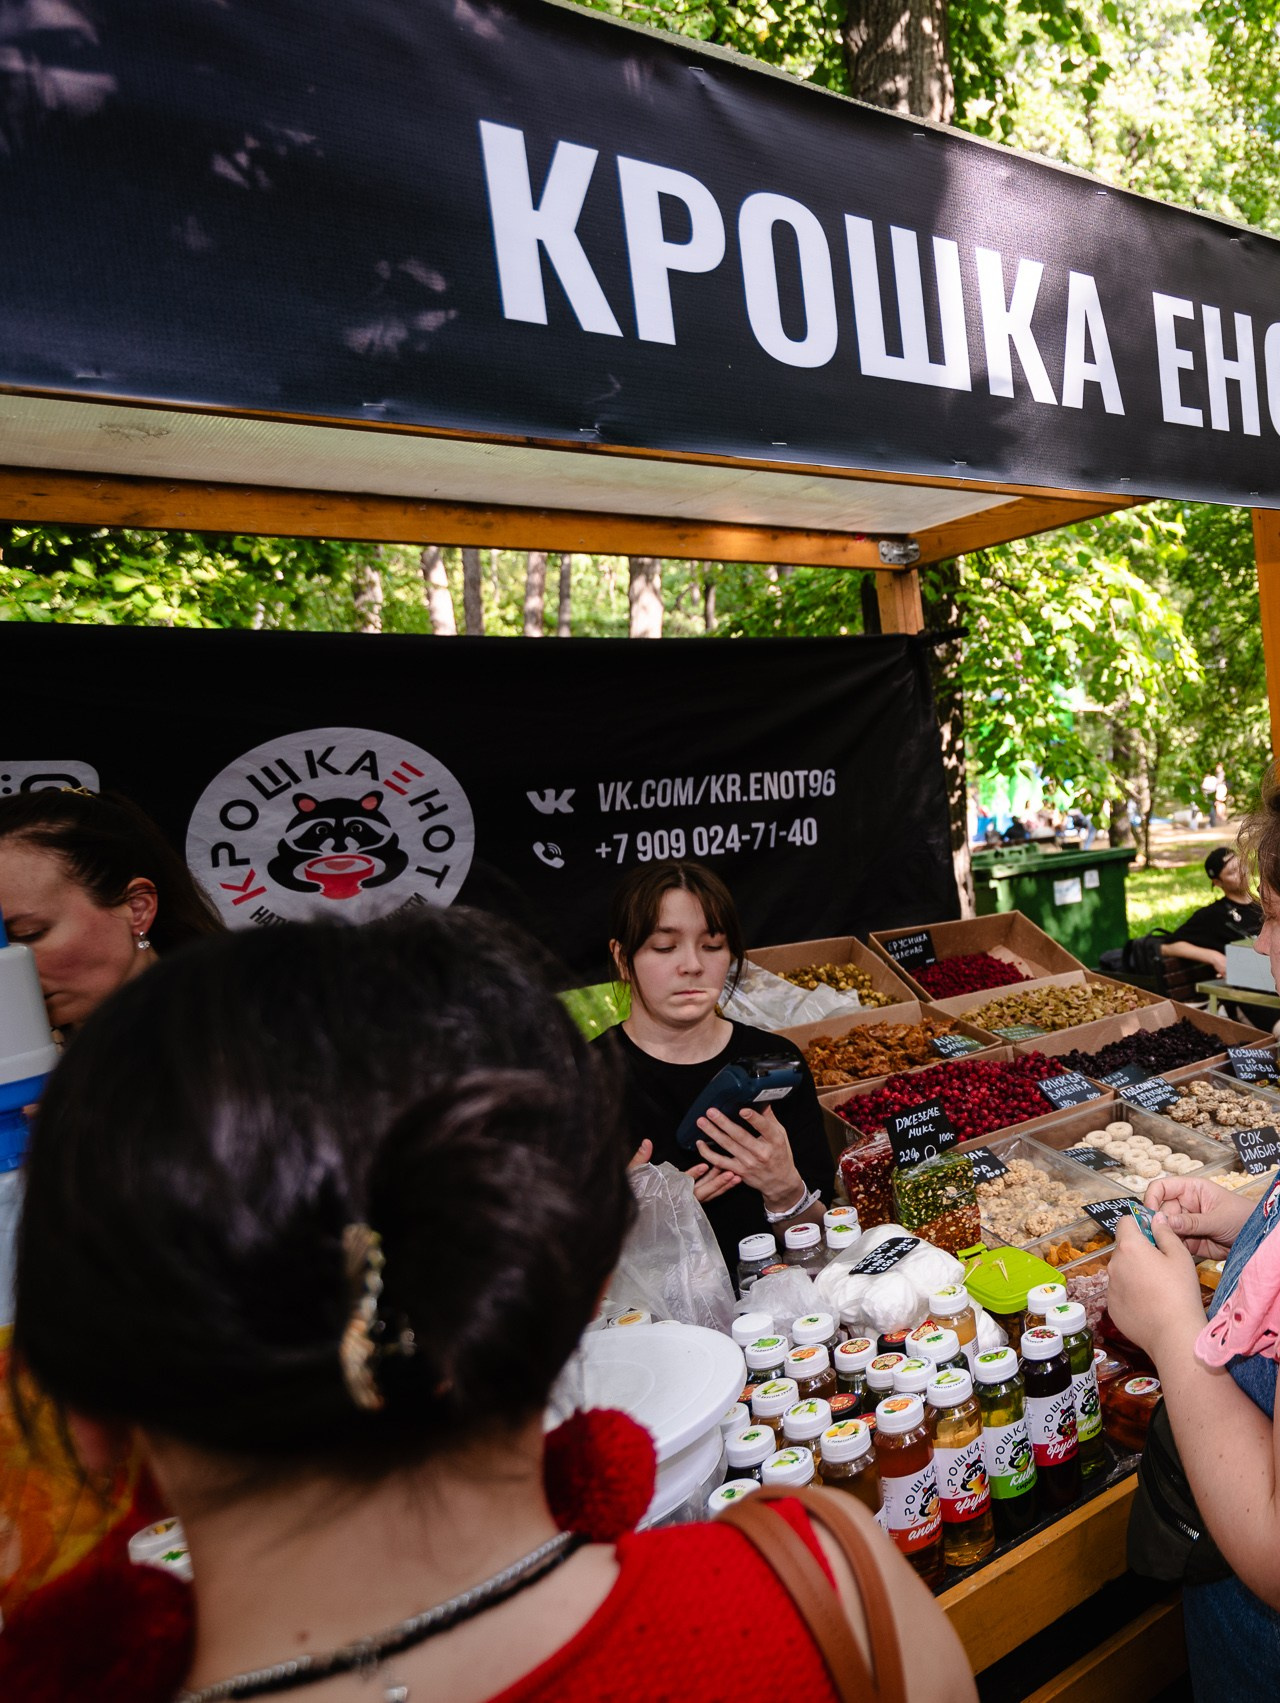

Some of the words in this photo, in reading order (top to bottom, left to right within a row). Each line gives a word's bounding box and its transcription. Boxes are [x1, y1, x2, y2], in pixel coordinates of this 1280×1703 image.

[479, 119, 1125, 416] КРОШКА
[598, 768, 836, 813] VK.COM/KR.ENOT96
[210, 745, 379, 906] КРОШКА
[383, 760, 456, 889] ЕНОТ
[595, 833, 629, 864] +7
[636, 828, 686, 863] 909
[693, 817, 818, 857] 024-71-40
[1038, 1072, 1085, 1092] КЛЮКВА
[908, 1123, 936, 1139] МИКС
[1239, 1131, 1264, 1147] СОК
[946, 1442, 980, 1498] КРОШКА
